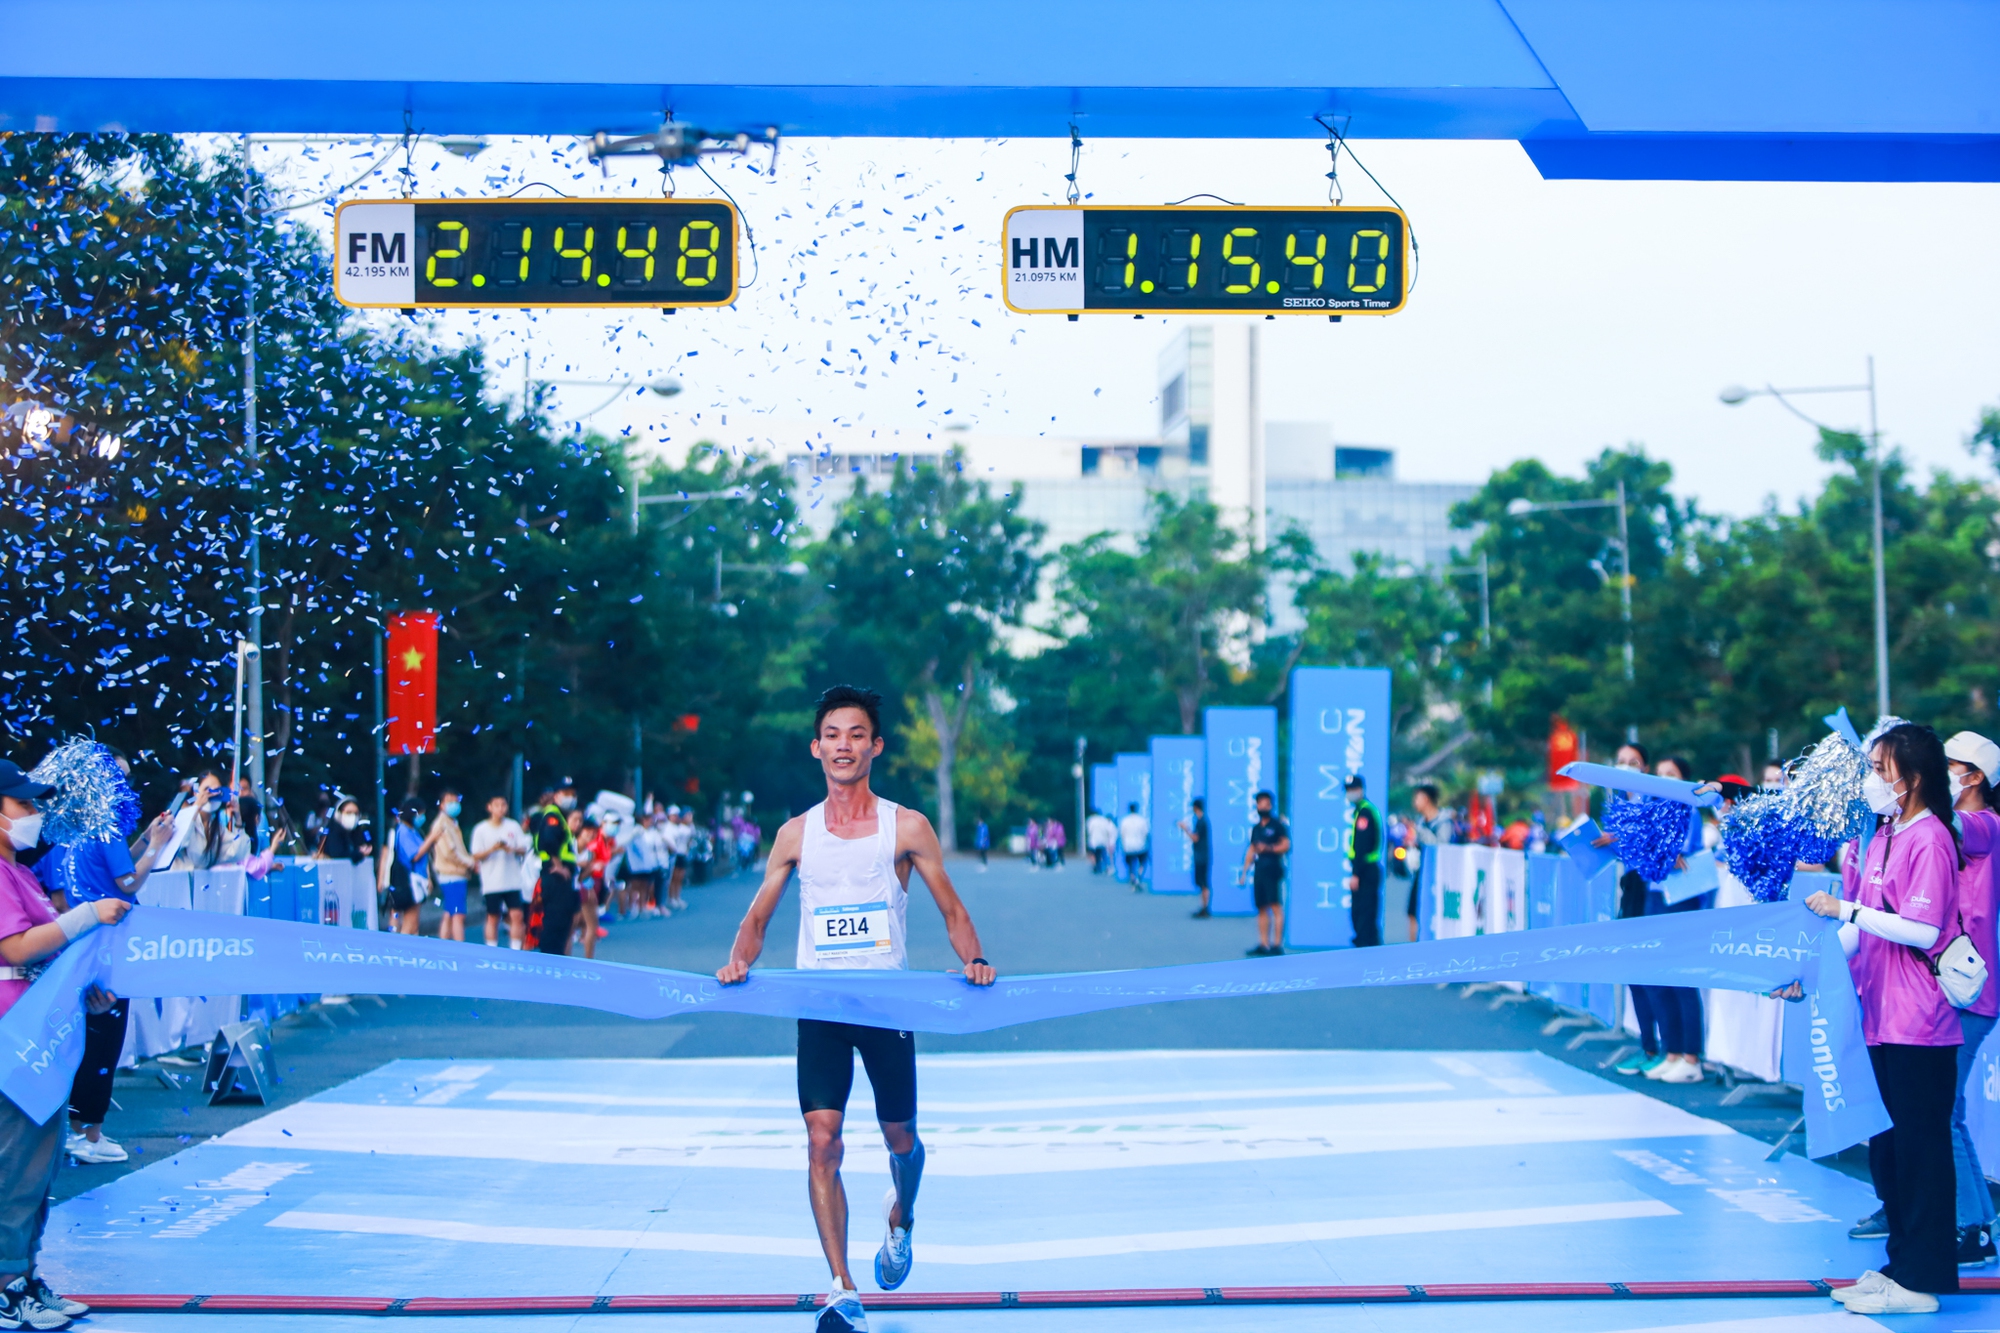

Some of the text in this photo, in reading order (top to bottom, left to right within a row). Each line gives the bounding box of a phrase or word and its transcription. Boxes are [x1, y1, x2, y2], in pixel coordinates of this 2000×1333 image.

[349, 233, 406, 263] FM
[1012, 237, 1079, 268] HM
[345, 266, 409, 277] 42.195 KM
[1015, 272, 1077, 282] 21.0975 KM
[1283, 298, 1391, 308] SEIKO Sports Timer
[826, 917, 869, 937] E214
[126, 934, 256, 962] Salonpas
